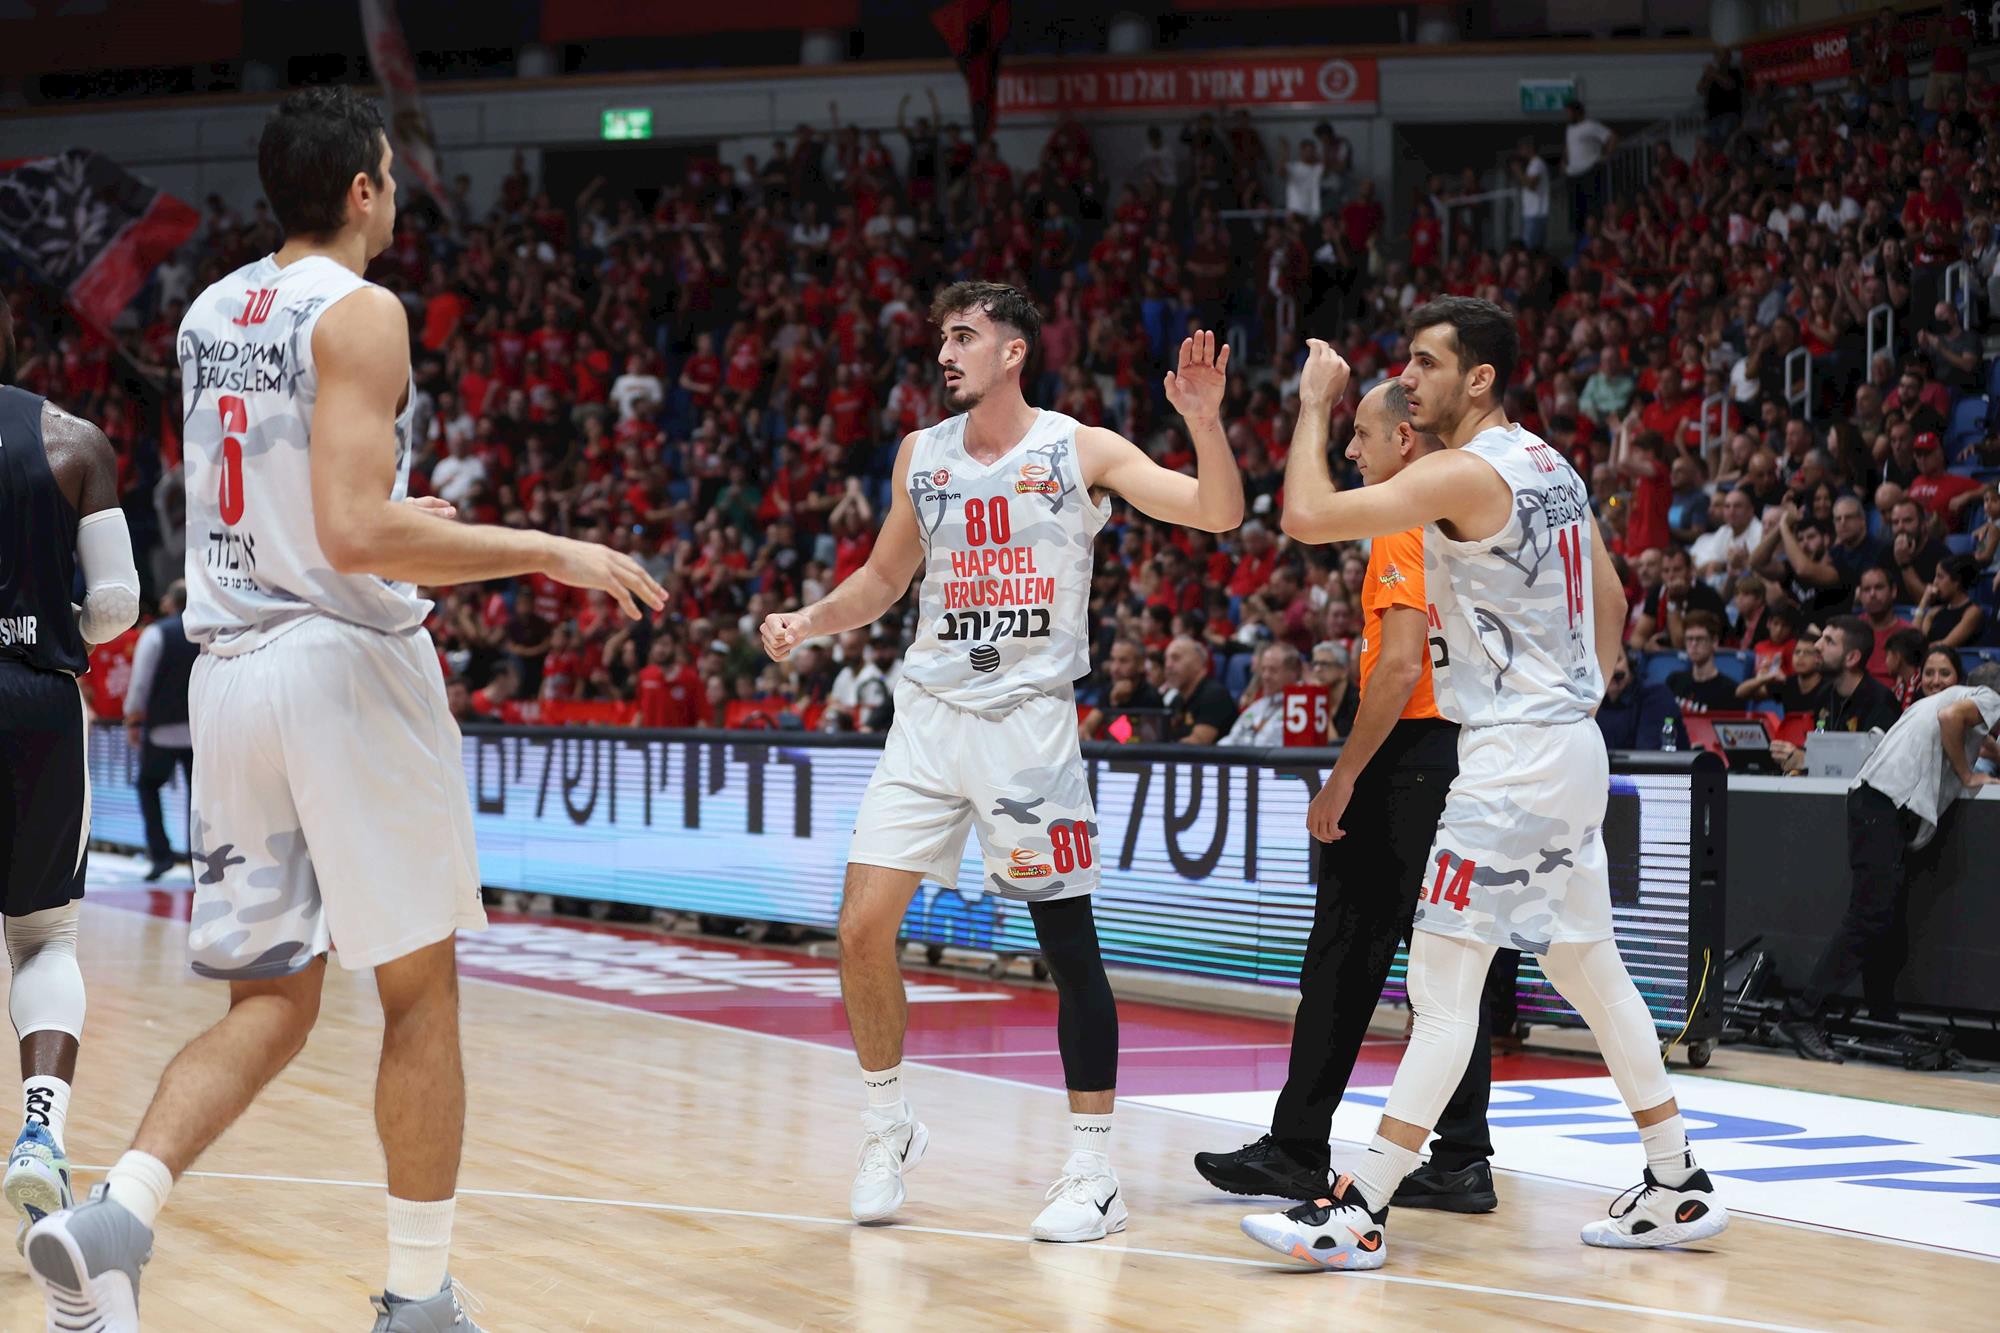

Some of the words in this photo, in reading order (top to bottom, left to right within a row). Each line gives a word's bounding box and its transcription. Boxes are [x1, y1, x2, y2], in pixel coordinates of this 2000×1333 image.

[1813, 37, 1848, 60] SHOP
[925, 493, 961, 502] GIVOVA
[964, 496, 1011, 547] 80
[951, 546, 1037, 578] HAPOEL
[944, 577, 1056, 610] JERUSALEM
[1286, 695, 1308, 733] 5
[1050, 820, 1093, 874] 80
[1430, 853, 1477, 912] 14
